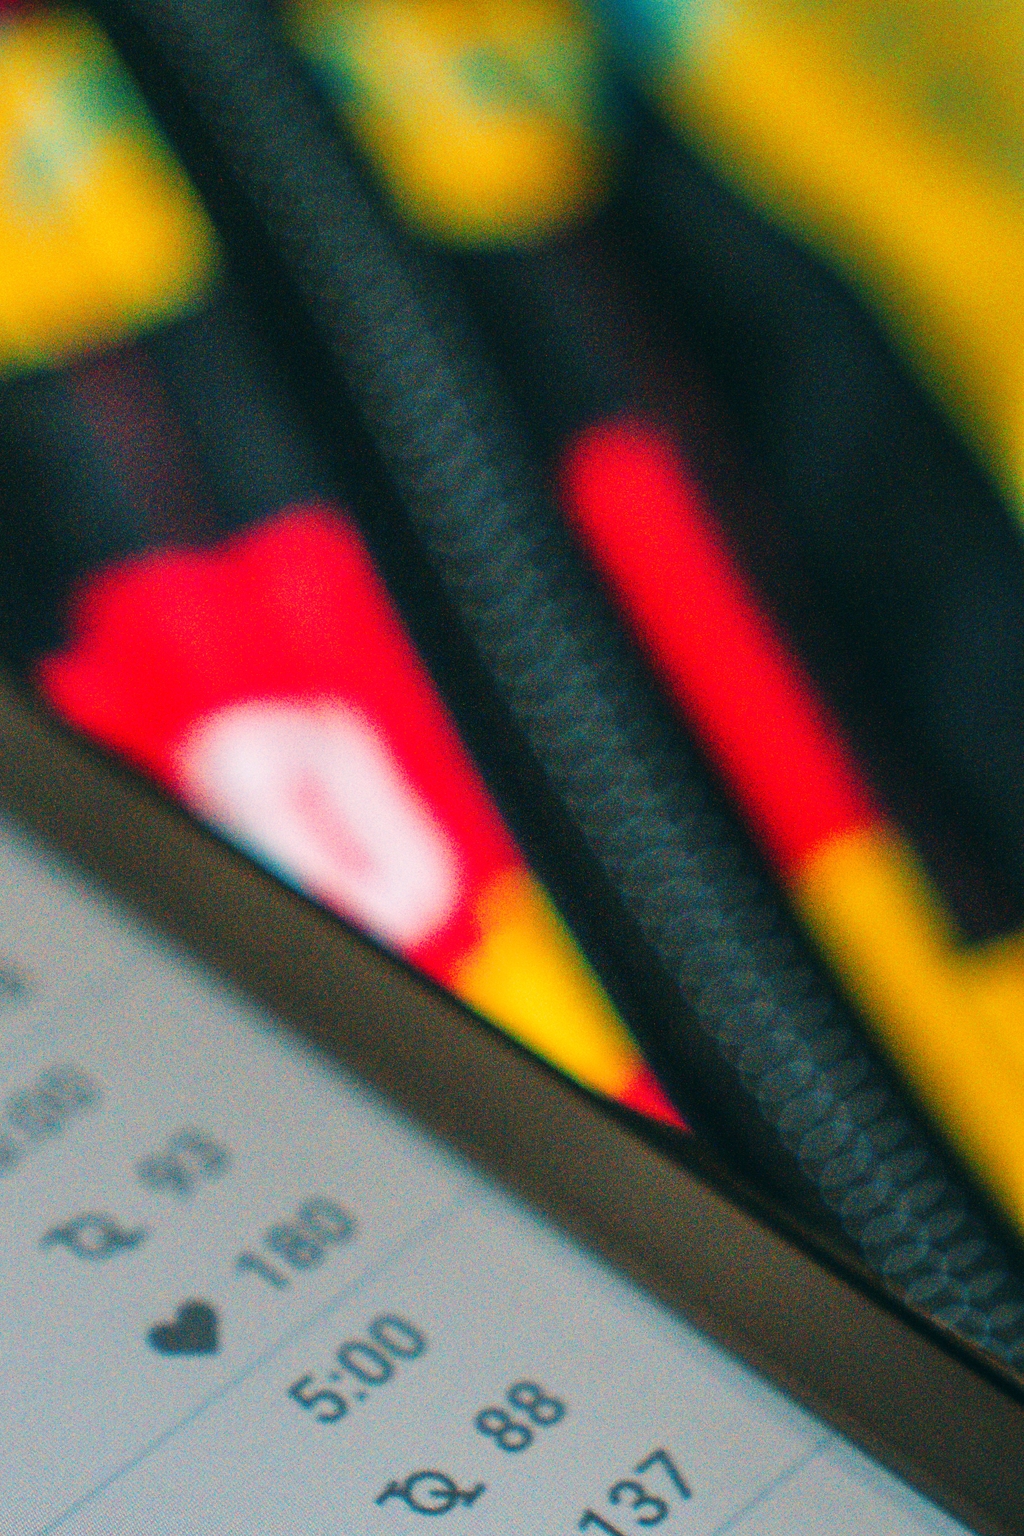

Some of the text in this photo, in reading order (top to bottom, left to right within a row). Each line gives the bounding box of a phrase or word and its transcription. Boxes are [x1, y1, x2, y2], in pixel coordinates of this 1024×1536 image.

[235, 1196, 359, 1288] 180
[288, 1310, 429, 1425] 5:00
[475, 1379, 569, 1454] 88
